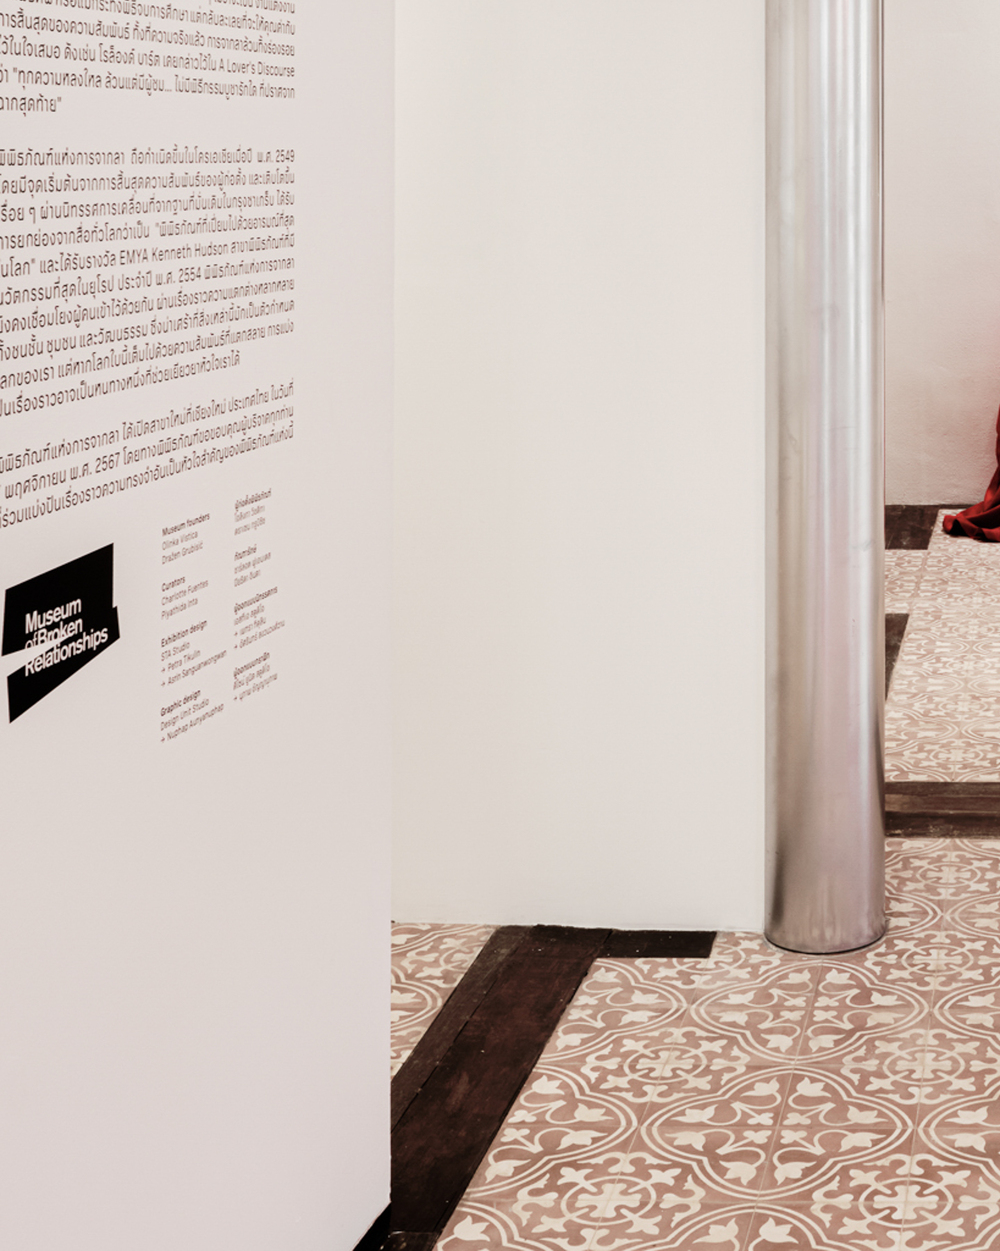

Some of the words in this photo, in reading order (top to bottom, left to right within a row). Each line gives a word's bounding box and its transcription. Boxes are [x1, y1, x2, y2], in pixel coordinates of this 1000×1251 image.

[64, 42, 95, 62] ดังเช่น
[219, 58, 225, 71] A
[227, 59, 255, 74] Lover's
[258, 61, 295, 78] Discourse
[276, 149, 295, 163] 2549
[0, 167, 246, 200] ดยมีจุดเริ่มต้นจากการสิ้นสุดความสัมพันธ์ของผู้ก่อตั้ง
[40, 250, 116, 278] และได้รับรางวัล
[120, 248, 148, 265] EMYA
[152, 244, 192, 261] Kenneth
[195, 242, 228, 257] Hudson
[179, 266, 201, 282] 2554
[47, 327, 78, 359] ชุมชน
[5, 470, 66, 499] พฤศจิกายน
[69, 462, 92, 481] พ.ศ.
[95, 452, 120, 473] 2567
[25, 598, 82, 634] Museum
[38, 618, 83, 646] Broken
[24, 627, 109, 677] Relationships
